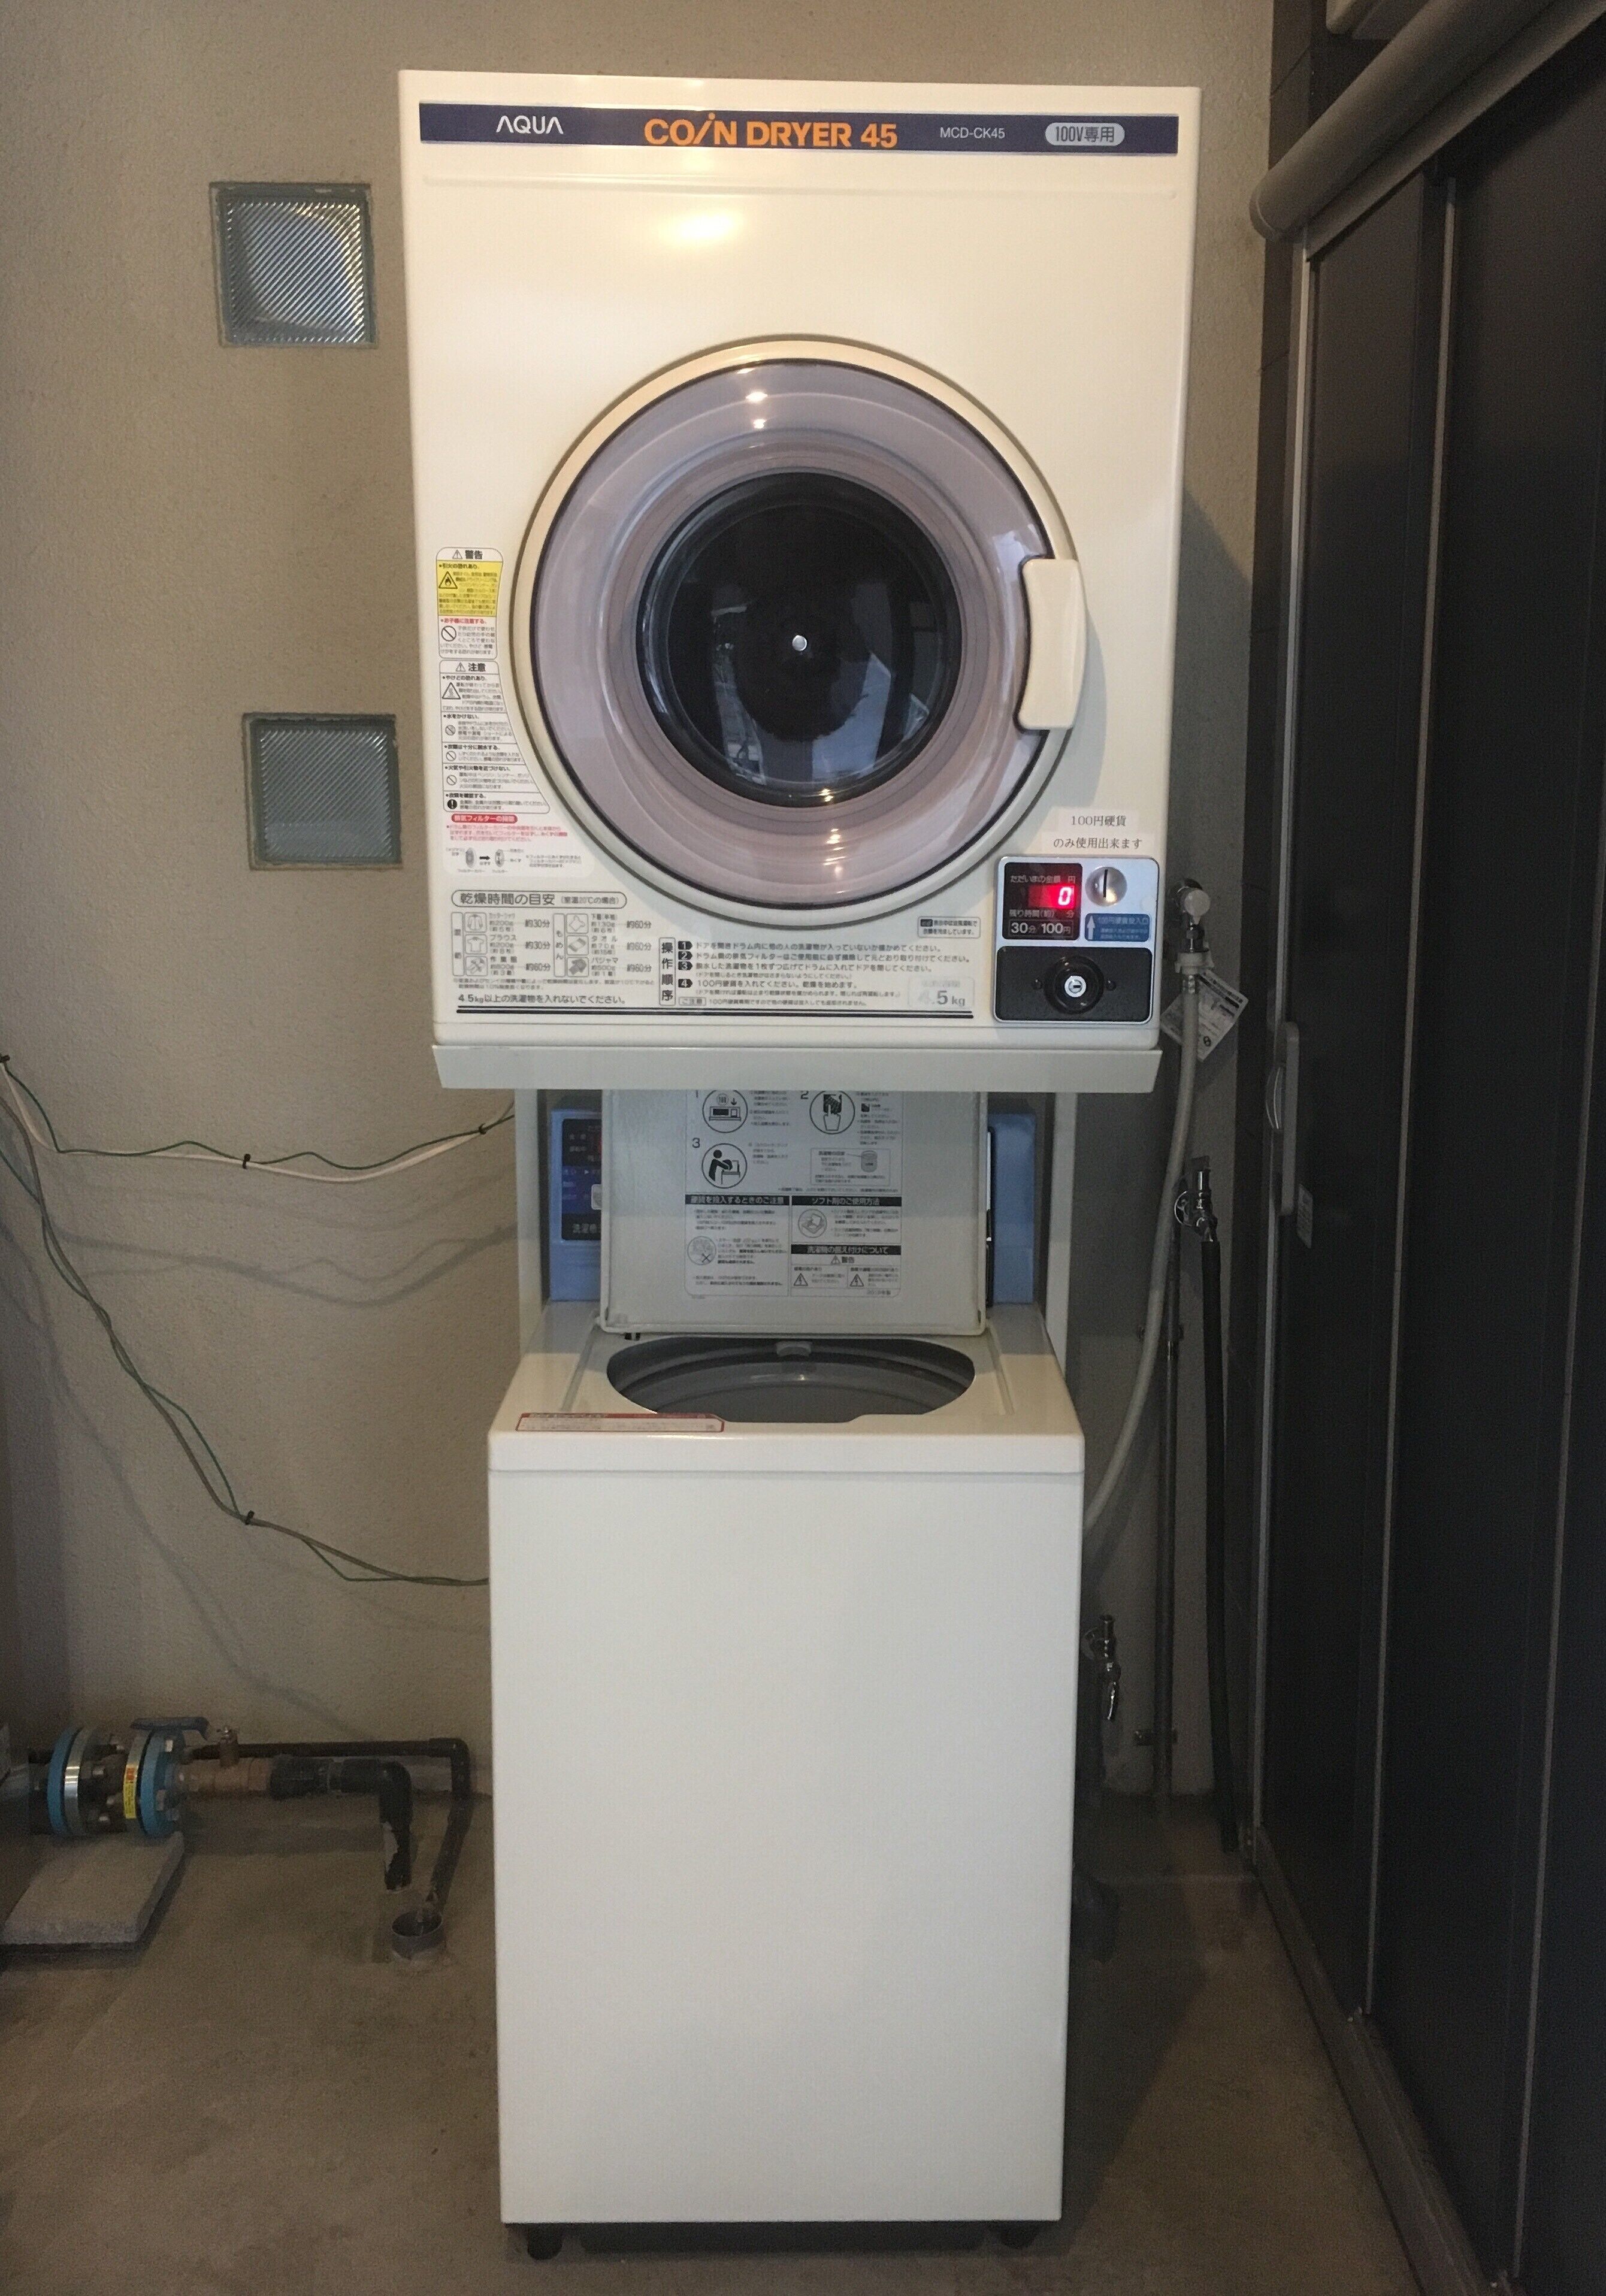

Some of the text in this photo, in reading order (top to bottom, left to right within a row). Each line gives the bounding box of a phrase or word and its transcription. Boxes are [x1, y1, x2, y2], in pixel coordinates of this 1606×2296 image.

[496, 115, 563, 134] AQUA
[644, 112, 897, 149] COIN DRYER 45
[940, 127, 1005, 139] MCD-CK45
[1055, 126, 1115, 143] 100V専用
[468, 663, 486, 671] 注意
[1071, 815, 1126, 827] 100円硬貨
[1053, 837, 1142, 849] のみ使用出来ます
[1067, 875, 1076, 884] 円
[460, 893, 555, 906] 乾燥時間の目安
[1058, 887, 1072, 906] 0
[1011, 922, 1071, 934] 30分 100円
[692, 1138, 700, 1148] 3
